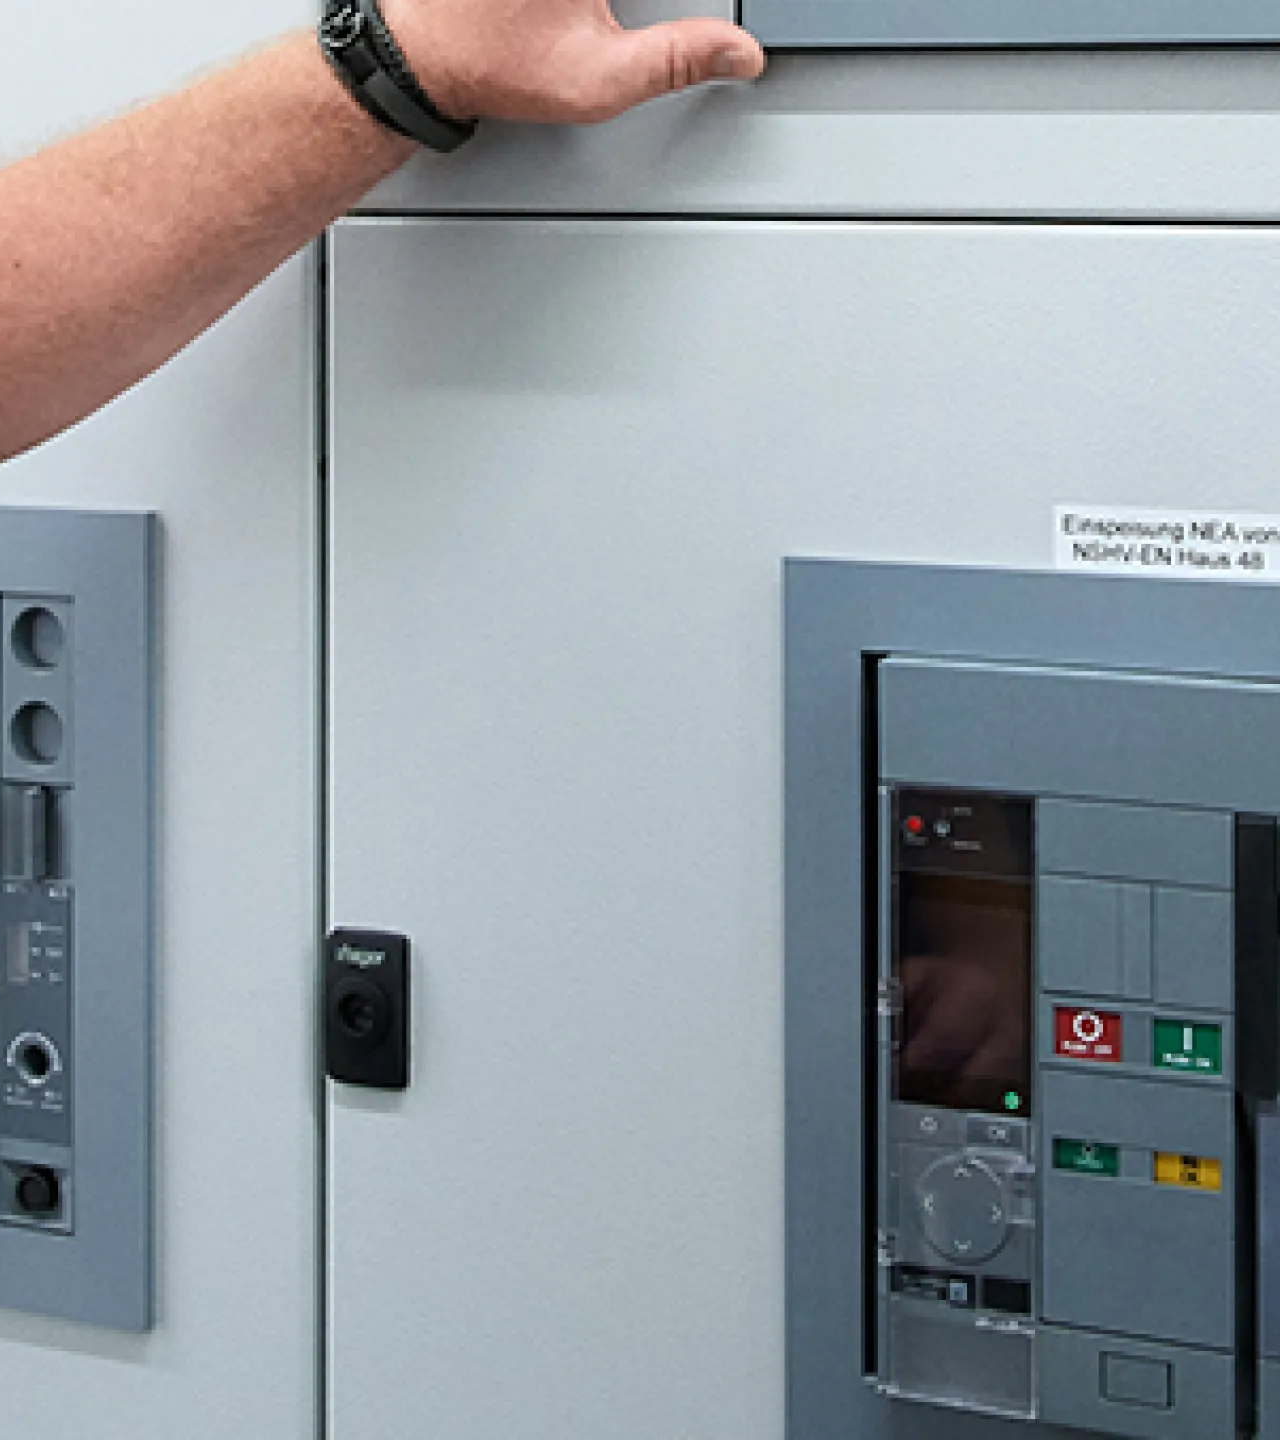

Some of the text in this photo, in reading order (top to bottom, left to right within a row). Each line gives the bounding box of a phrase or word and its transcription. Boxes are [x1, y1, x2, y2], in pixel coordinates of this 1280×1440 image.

[1189, 520, 1237, 543] NEA
[1176, 547, 1231, 570] Haus
[1235, 550, 1265, 570] 48
